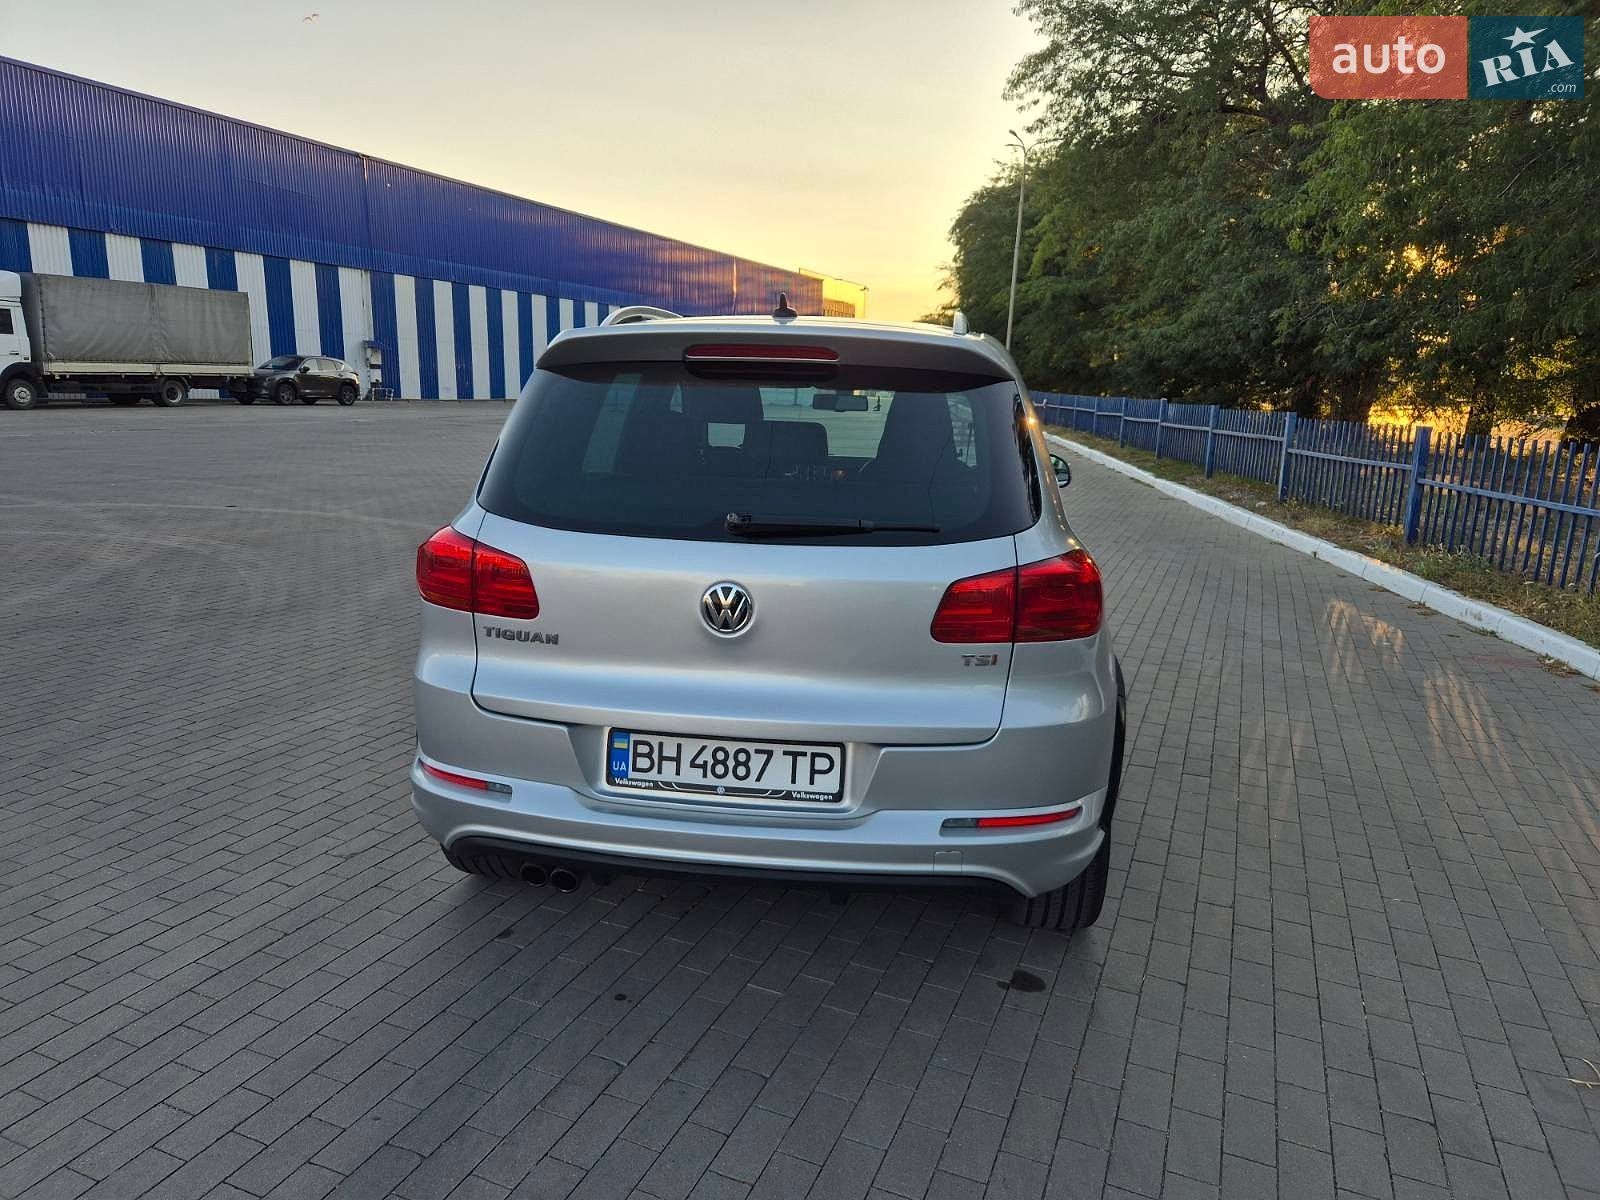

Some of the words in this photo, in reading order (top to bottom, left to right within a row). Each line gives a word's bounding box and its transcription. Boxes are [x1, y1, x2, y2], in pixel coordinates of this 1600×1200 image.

[483, 626, 559, 645] TIGUAN
[612, 761, 627, 772] UA
[631, 739, 682, 776] BH
[689, 744, 774, 783] 4887
[782, 750, 835, 786] TP
[615, 777, 654, 788] Volkswagen
[791, 791, 833, 801] Volkswagen
